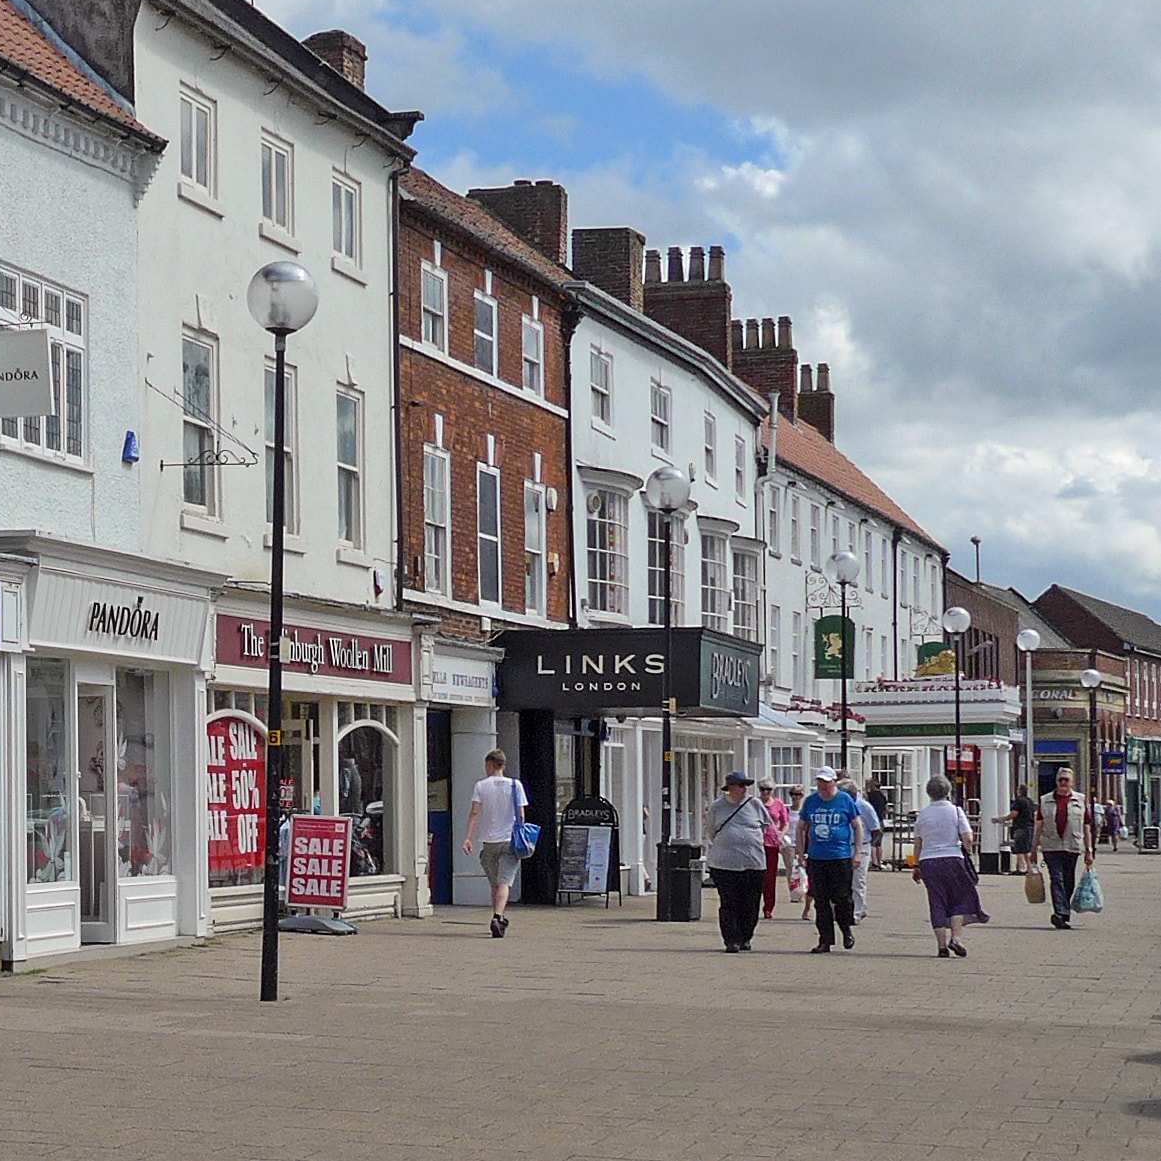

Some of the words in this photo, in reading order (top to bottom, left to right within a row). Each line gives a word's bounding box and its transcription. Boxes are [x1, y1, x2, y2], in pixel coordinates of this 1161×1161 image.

[89, 596, 159, 641] PANDORA
[241, 623, 265, 657] The
[277, 628, 325, 673] nburgh
[329, 637, 369, 670] Woollen
[373, 644, 393, 673] Mill
[537, 654, 665, 675] LINKS
[562, 682, 641, 691] LONDON
[1031, 689, 1075, 700] CORAL
[207, 736, 226, 766] ALE
[229, 721, 258, 761] SALE
[207, 773, 227, 804] ALE
[232, 770, 260, 810] 50%
[207, 810, 229, 841] ALE
[237, 813, 259, 855] OFF
[294, 836, 344, 857] SALE
[292, 857, 343, 877] SALE
[291, 877, 342, 898] SALE
